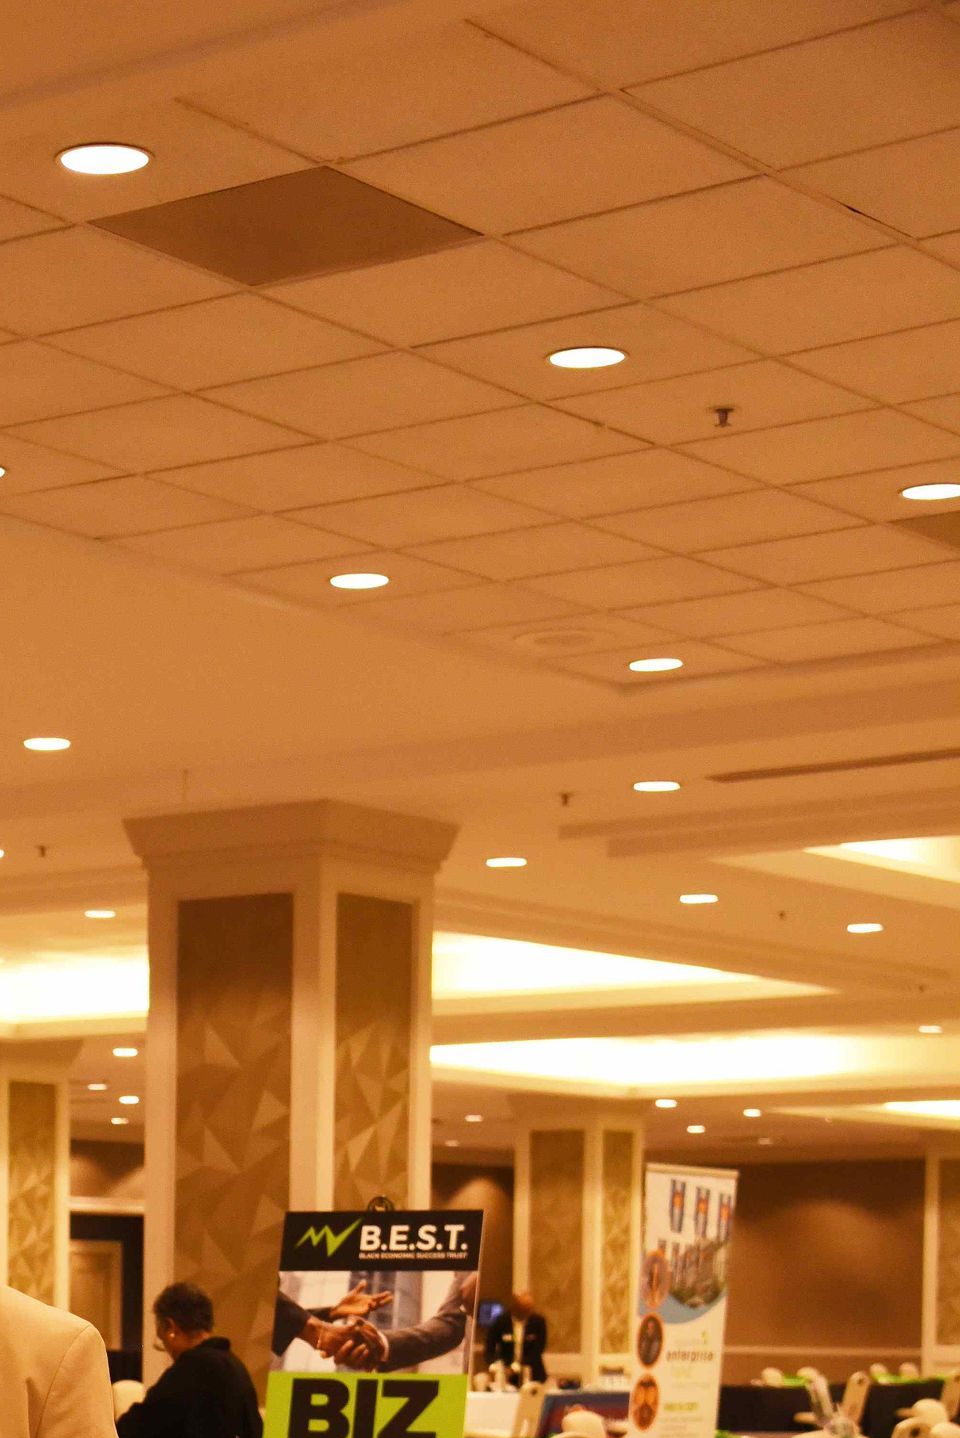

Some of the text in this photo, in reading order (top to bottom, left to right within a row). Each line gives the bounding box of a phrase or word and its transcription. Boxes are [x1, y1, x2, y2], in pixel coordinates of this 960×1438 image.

[360, 1224, 468, 1251] B.E.S.T.
[381, 1251, 415, 1260] ECONOMIC
[416, 1252, 445, 1260] SUCCESS
[446, 1252, 468, 1260] TRUST
